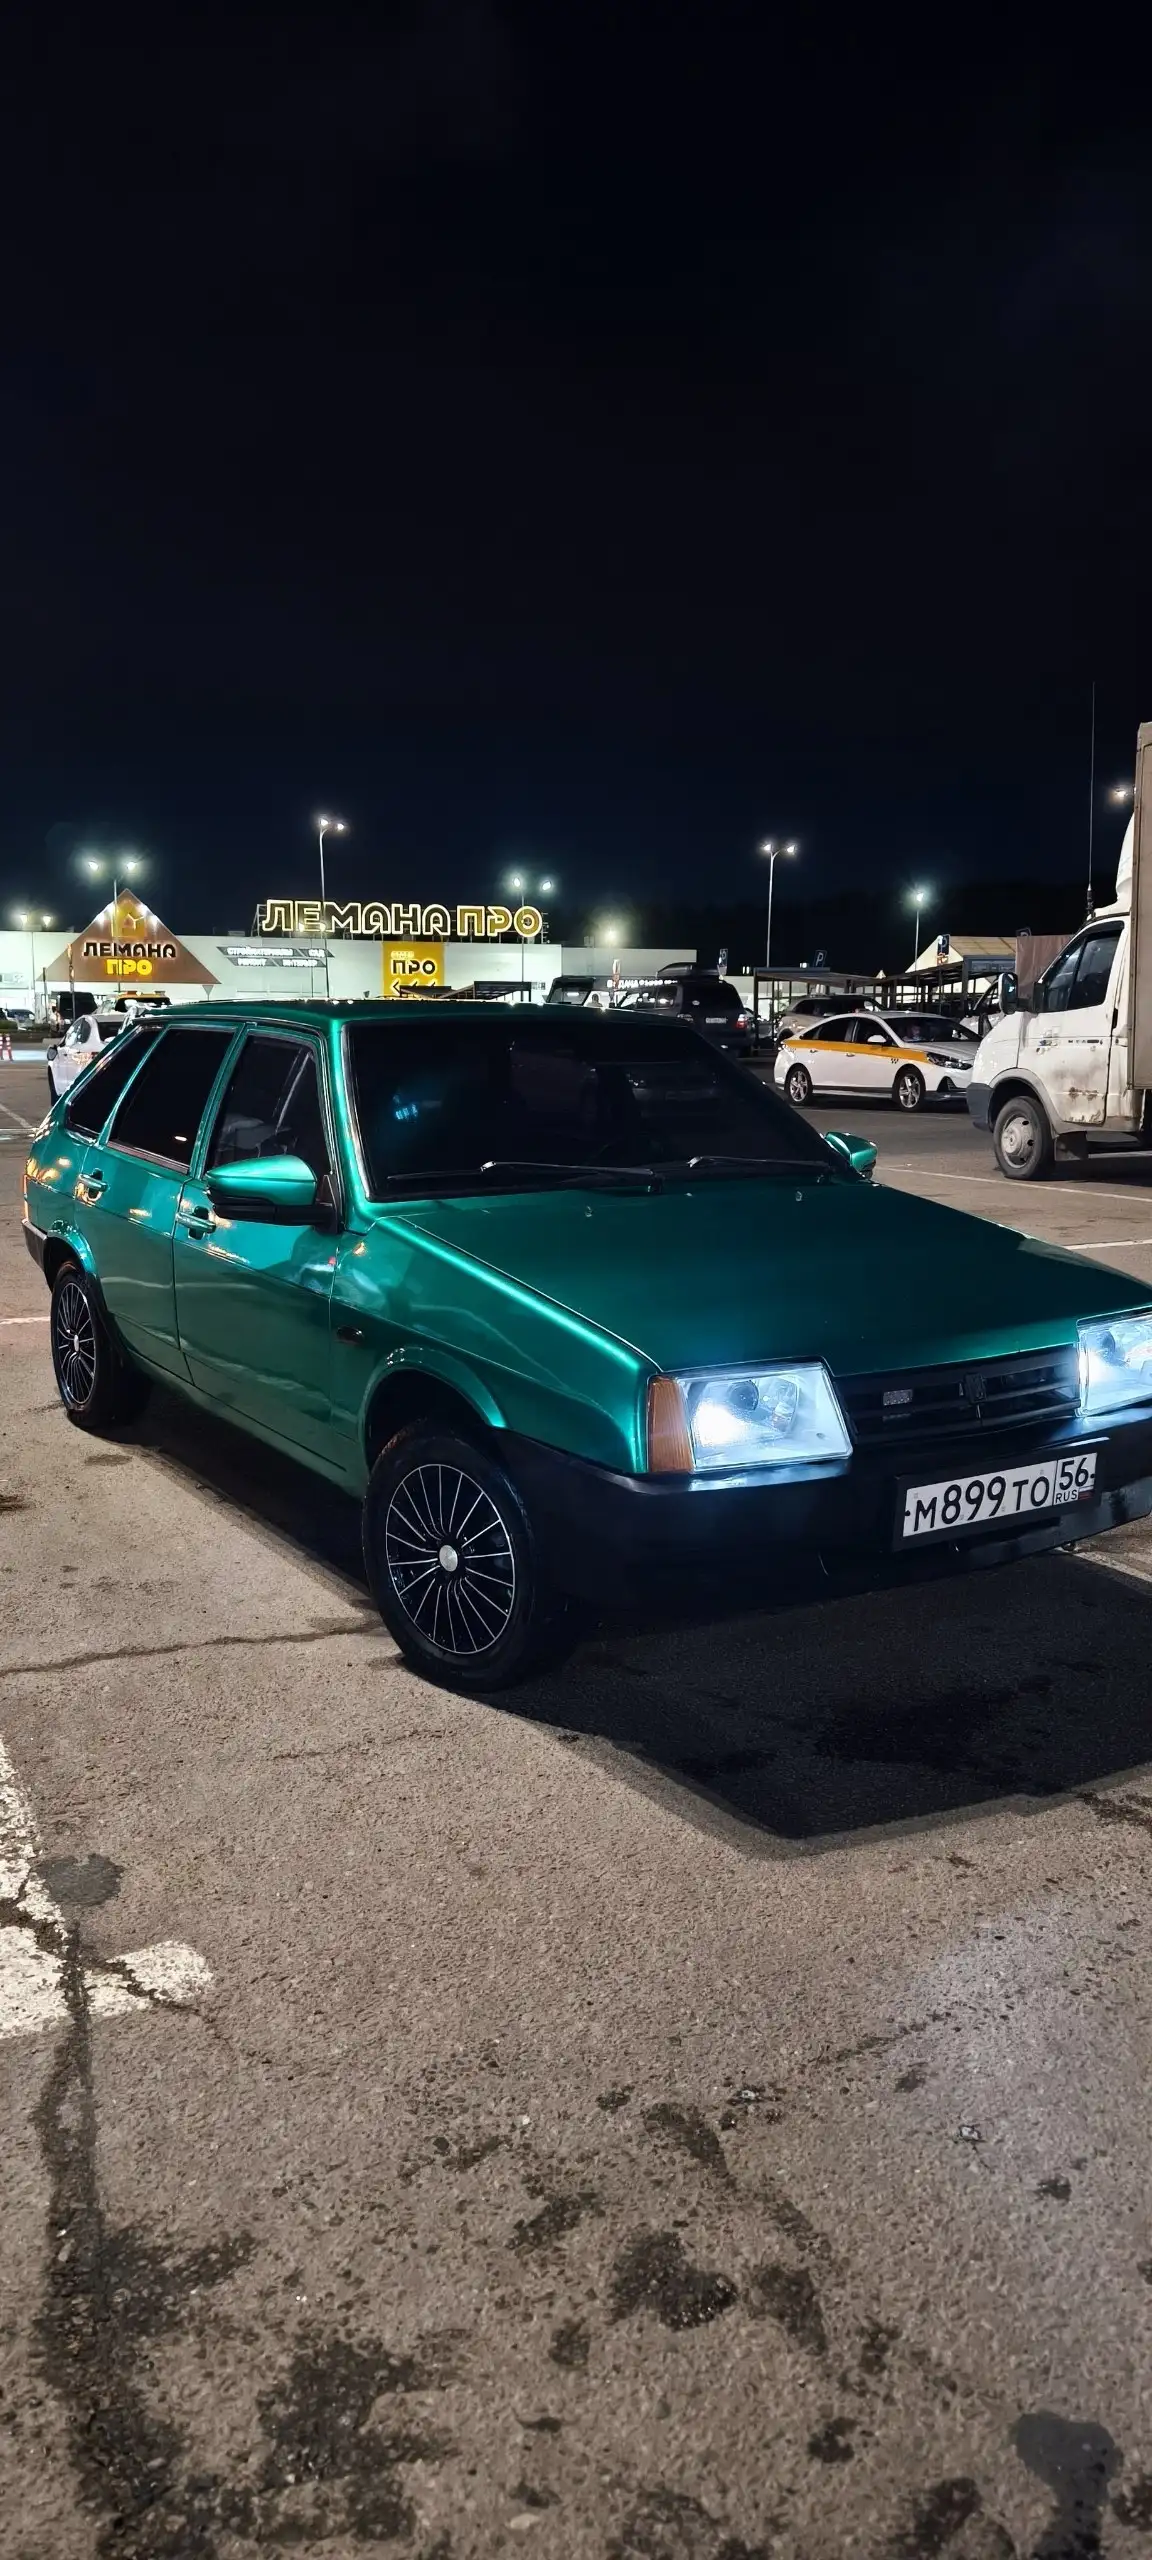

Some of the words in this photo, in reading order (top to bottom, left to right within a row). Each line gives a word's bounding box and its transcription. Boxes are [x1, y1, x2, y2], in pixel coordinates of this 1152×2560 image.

[262, 899, 451, 937] ЛЕМАНА
[456, 904, 543, 938] ПРО
[82, 941, 177, 958] ЛЕМАНА
[391, 959, 437, 976] ПРО
[815, 951, 824, 967] P
[105, 959, 153, 977] ПРО
[913, 1475, 1050, 1532] М899ТО
[1058, 1457, 1089, 1490] 56
[1055, 1489, 1078, 1503] RUS
